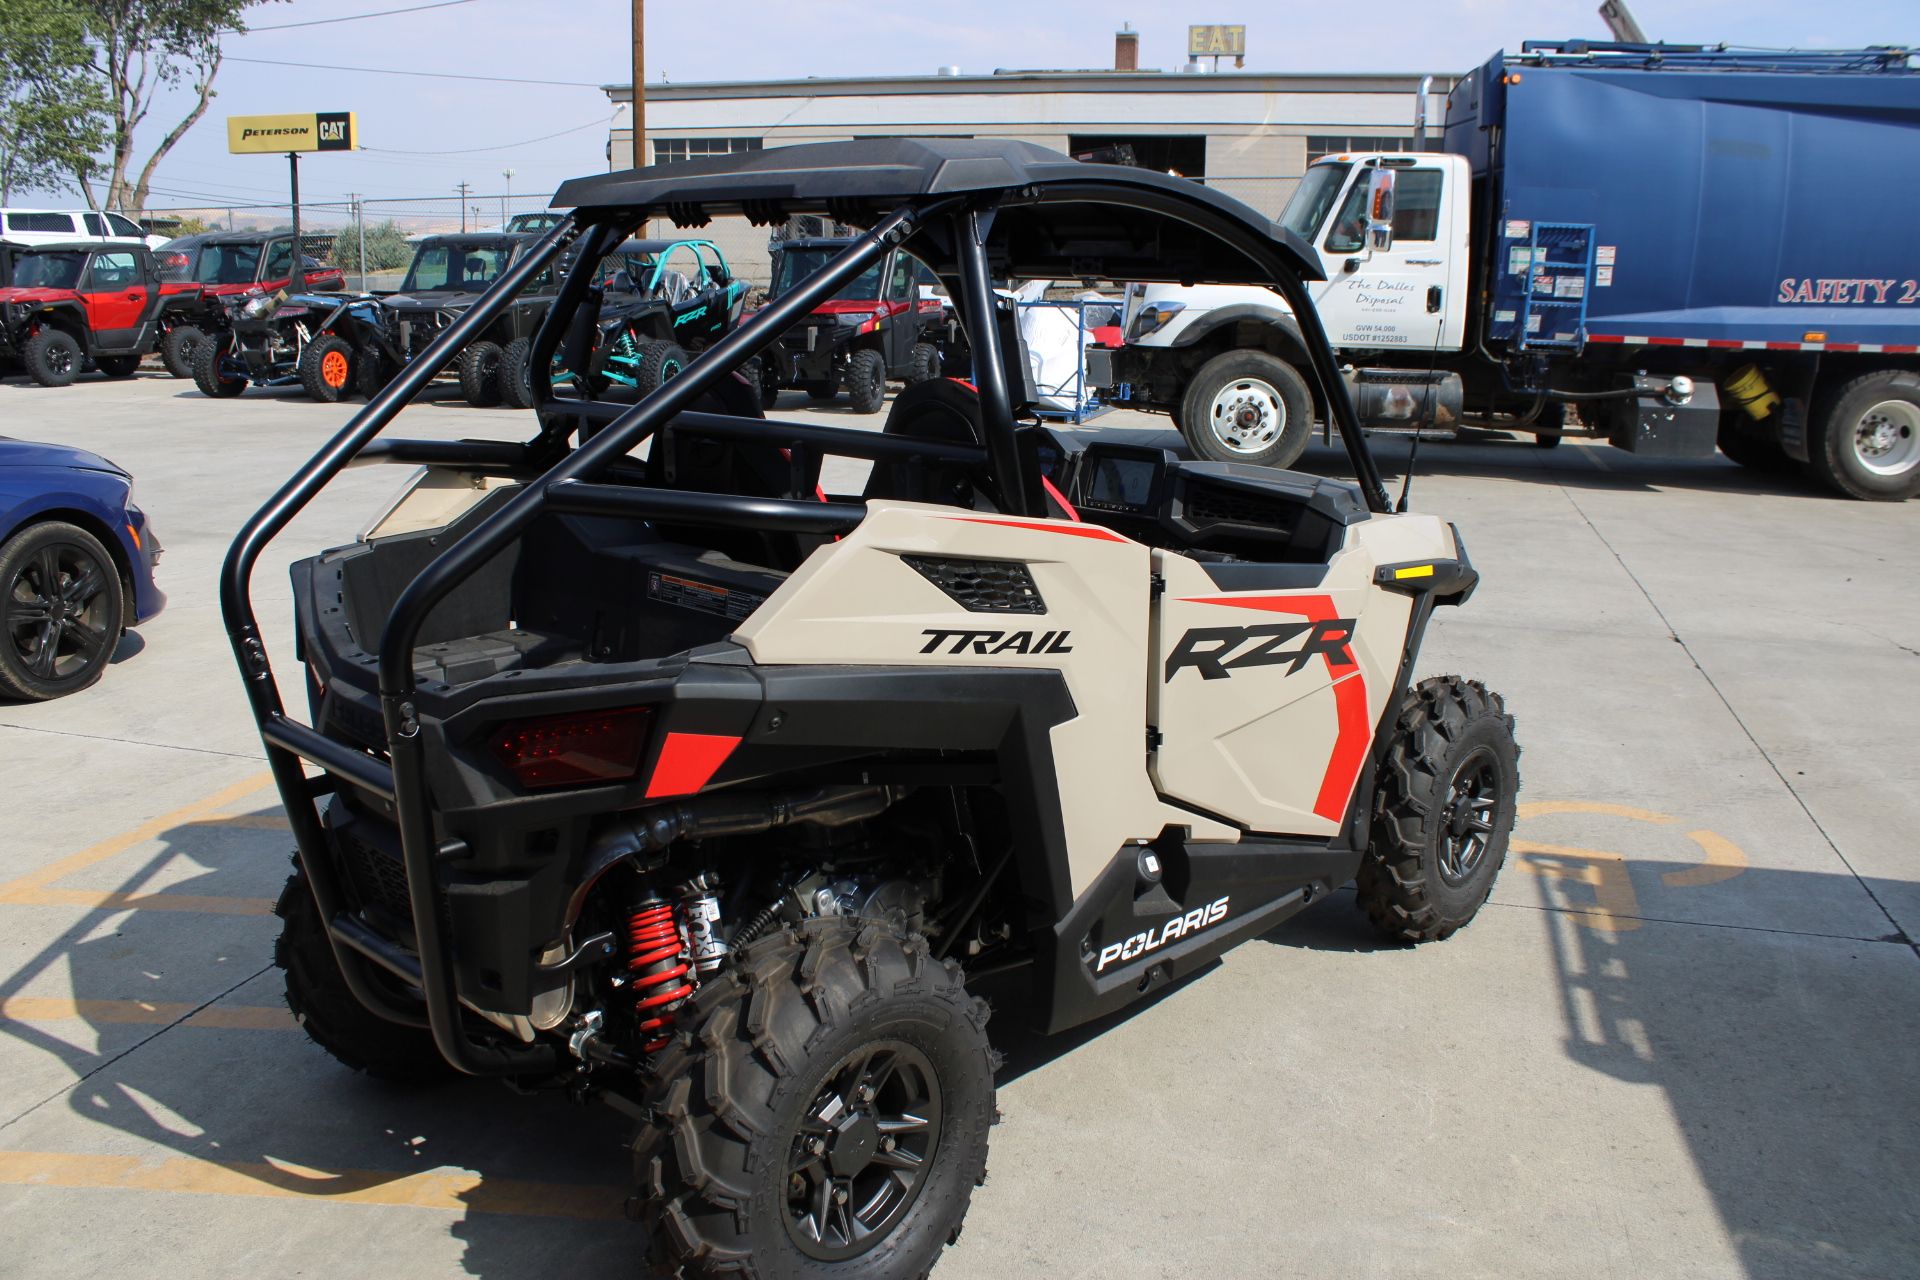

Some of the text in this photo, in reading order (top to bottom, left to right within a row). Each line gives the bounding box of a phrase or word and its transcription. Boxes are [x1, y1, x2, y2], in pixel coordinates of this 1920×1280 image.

[1191, 27, 1243, 52] EAT
[319, 121, 346, 141] CAT
[1346, 279, 1415, 291] The Dalles
[1777, 278, 1920, 304] SAFETY 2
[1356, 293, 1404, 307] Disposal
[674, 306, 707, 328] RZR
[1355, 324, 1373, 332] GVW
[1342, 333, 1371, 341] USDOT
[919, 629, 1073, 654] TRAIL
[1165, 618, 1357, 684] RZR
[1096, 895, 1230, 972] POLARIS
